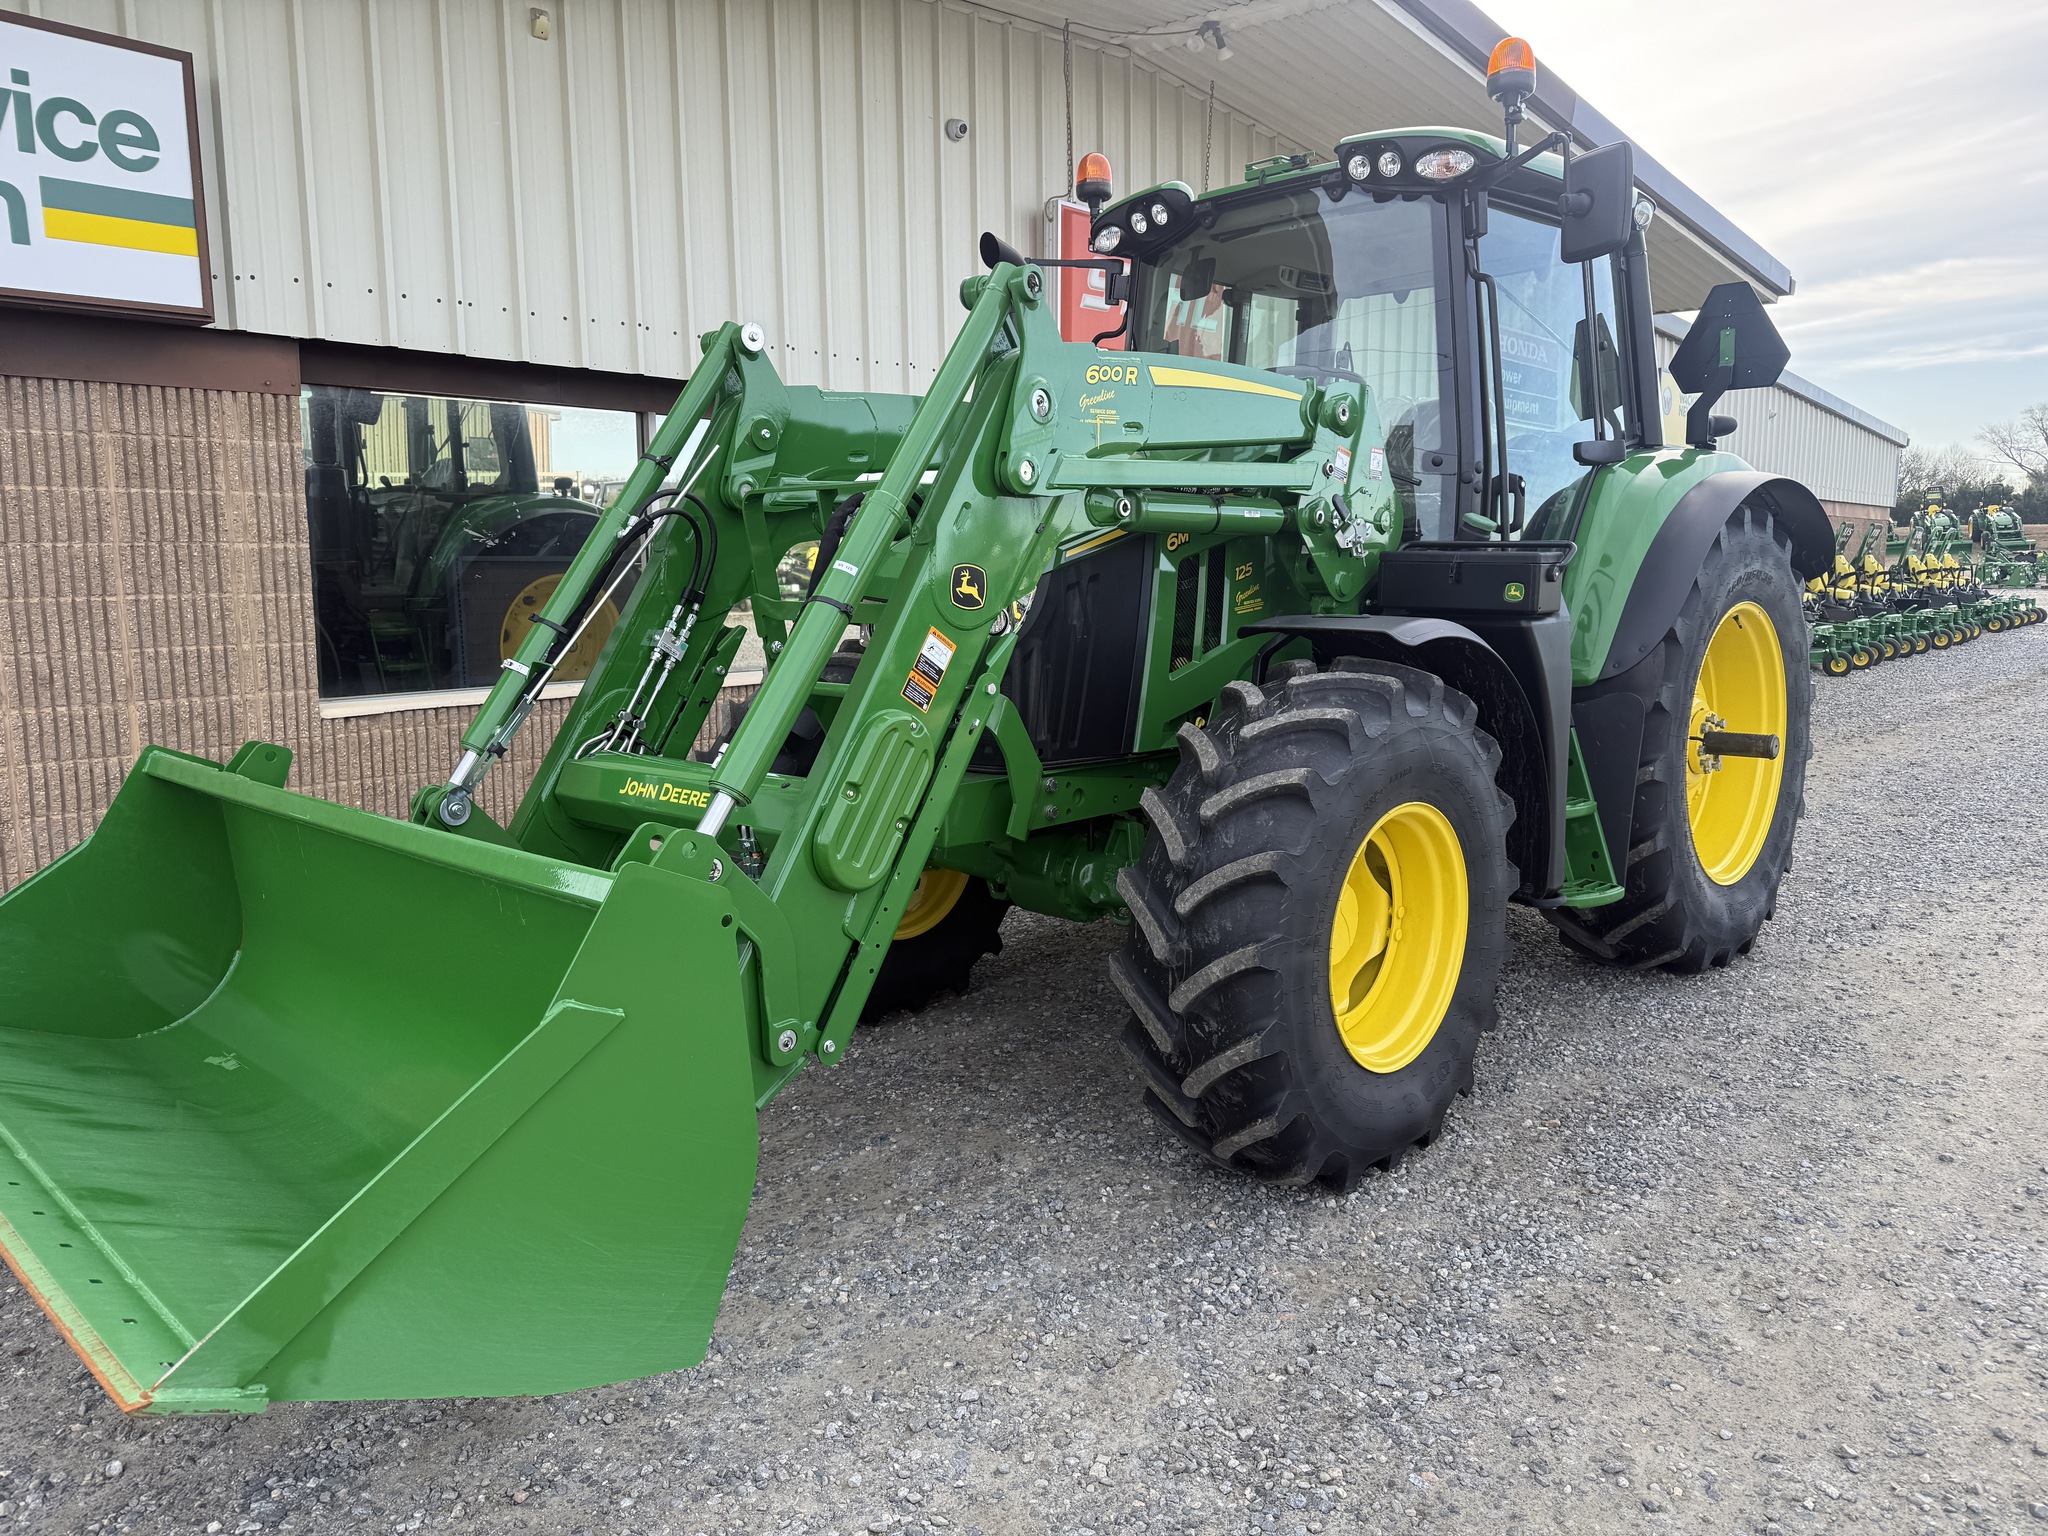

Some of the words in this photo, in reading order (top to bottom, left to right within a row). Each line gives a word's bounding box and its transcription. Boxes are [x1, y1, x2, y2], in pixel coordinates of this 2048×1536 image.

[1500, 334, 1548, 363] HONDA
[1502, 368, 1522, 385] ower
[1079, 389, 1116, 412] Greenline
[1504, 394, 1539, 415] uipment
[1167, 532, 1189, 551] 6M
[1235, 562, 1253, 581] 125
[619, 777, 659, 799] JOHN
[659, 782, 711, 808] DEERE
